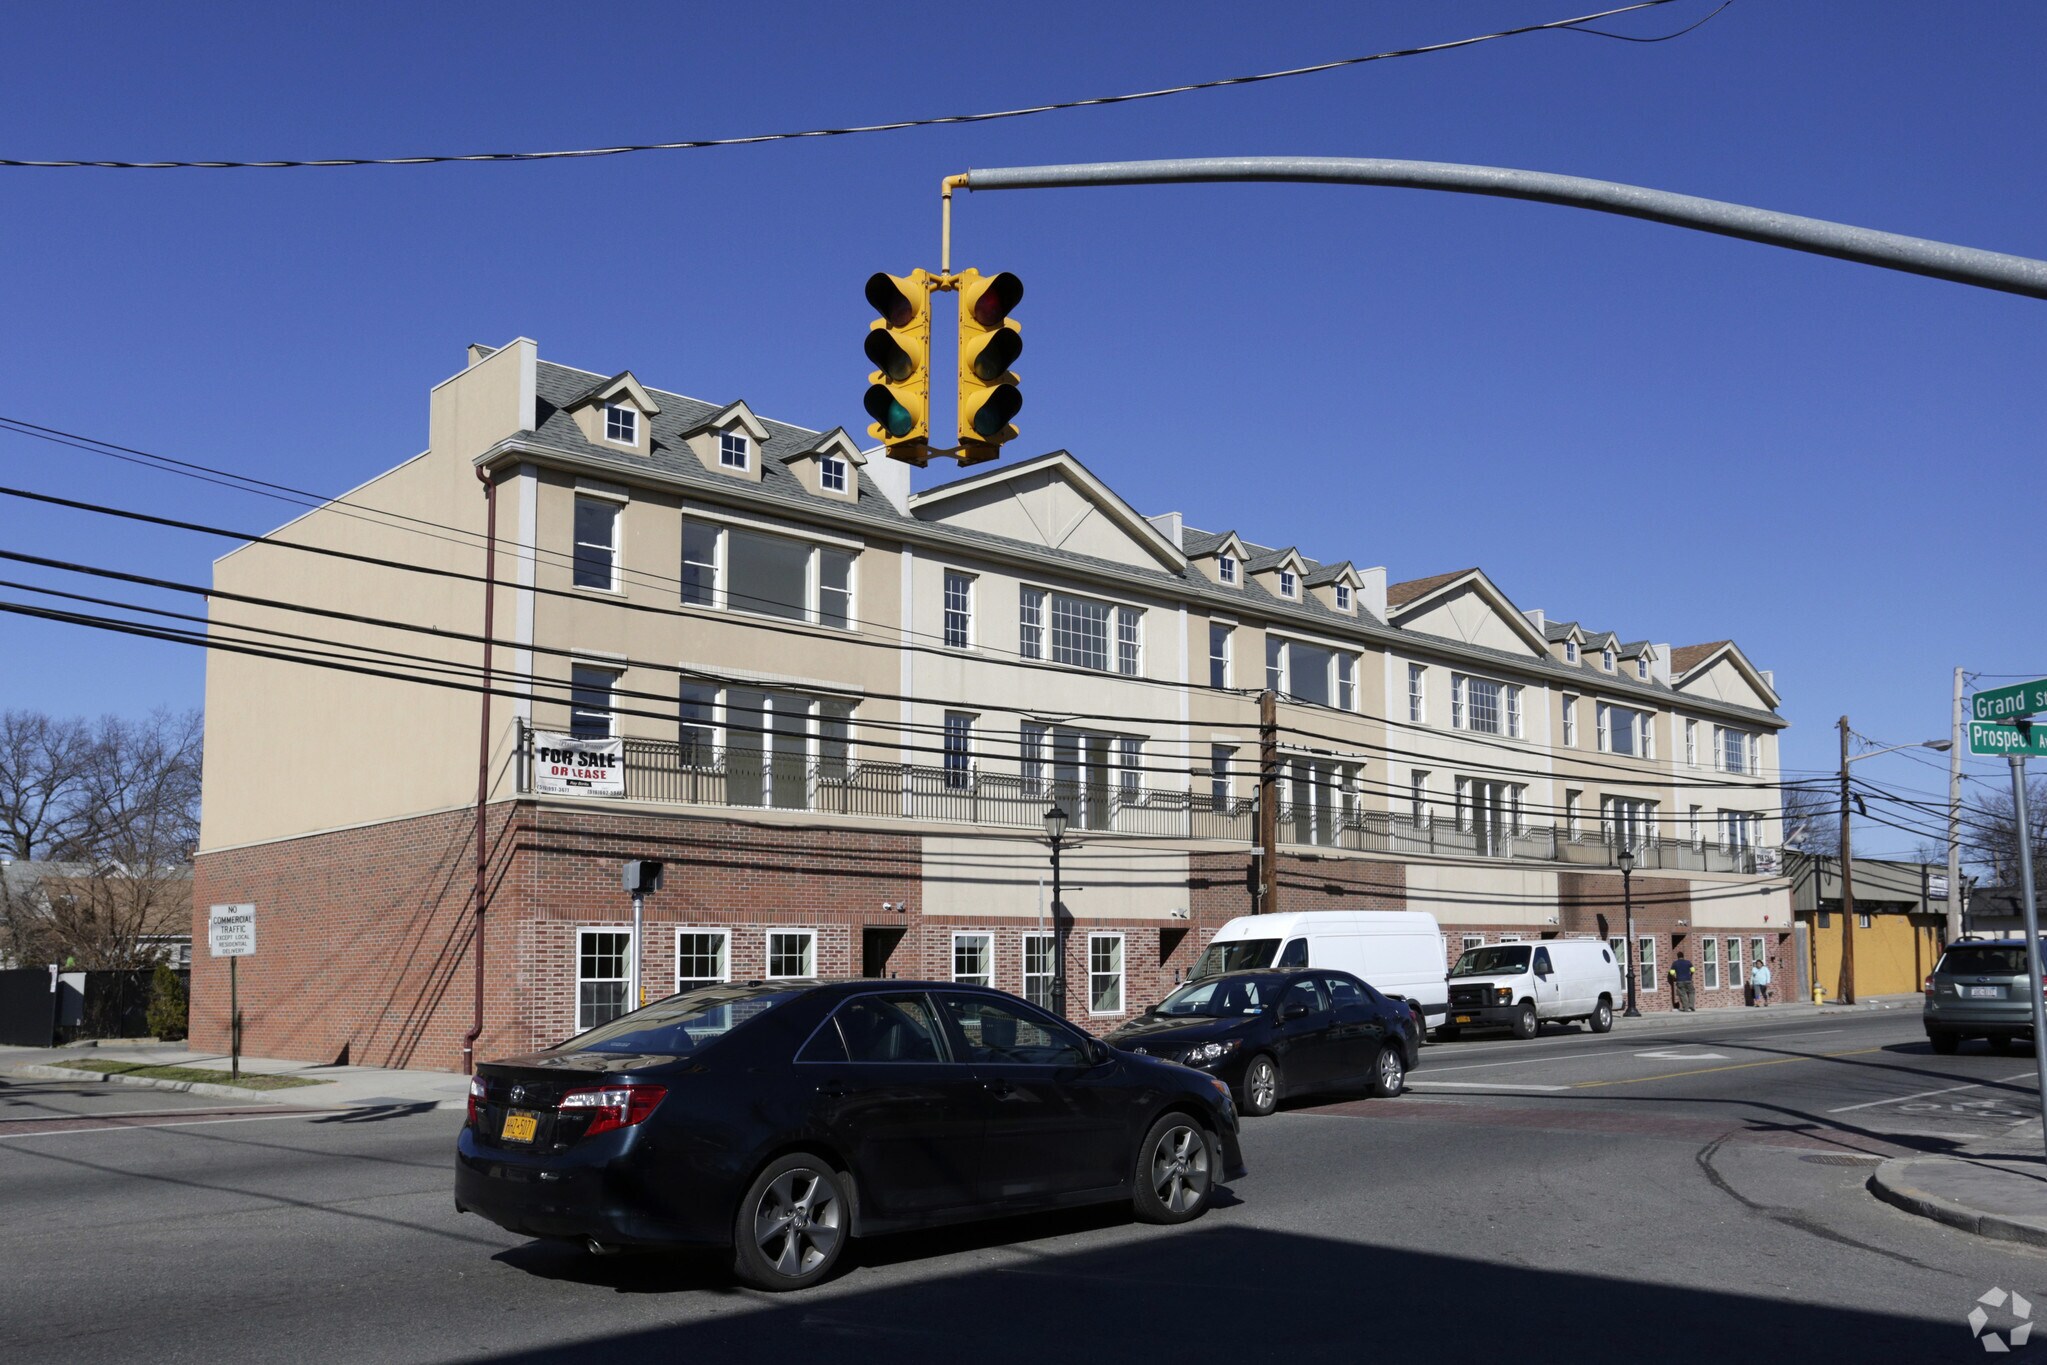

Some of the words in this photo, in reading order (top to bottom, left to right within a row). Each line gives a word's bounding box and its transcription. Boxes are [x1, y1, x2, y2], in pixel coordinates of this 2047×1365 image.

[1976, 690, 2025, 718] Grand
[1973, 725, 2029, 752] Prospec
[541, 747, 573, 766] FOR
[578, 751, 615, 768] SALE
[551, 766, 568, 776] OR
[572, 768, 607, 779] LEASE
[213, 916, 253, 925] COMMERCIAL
